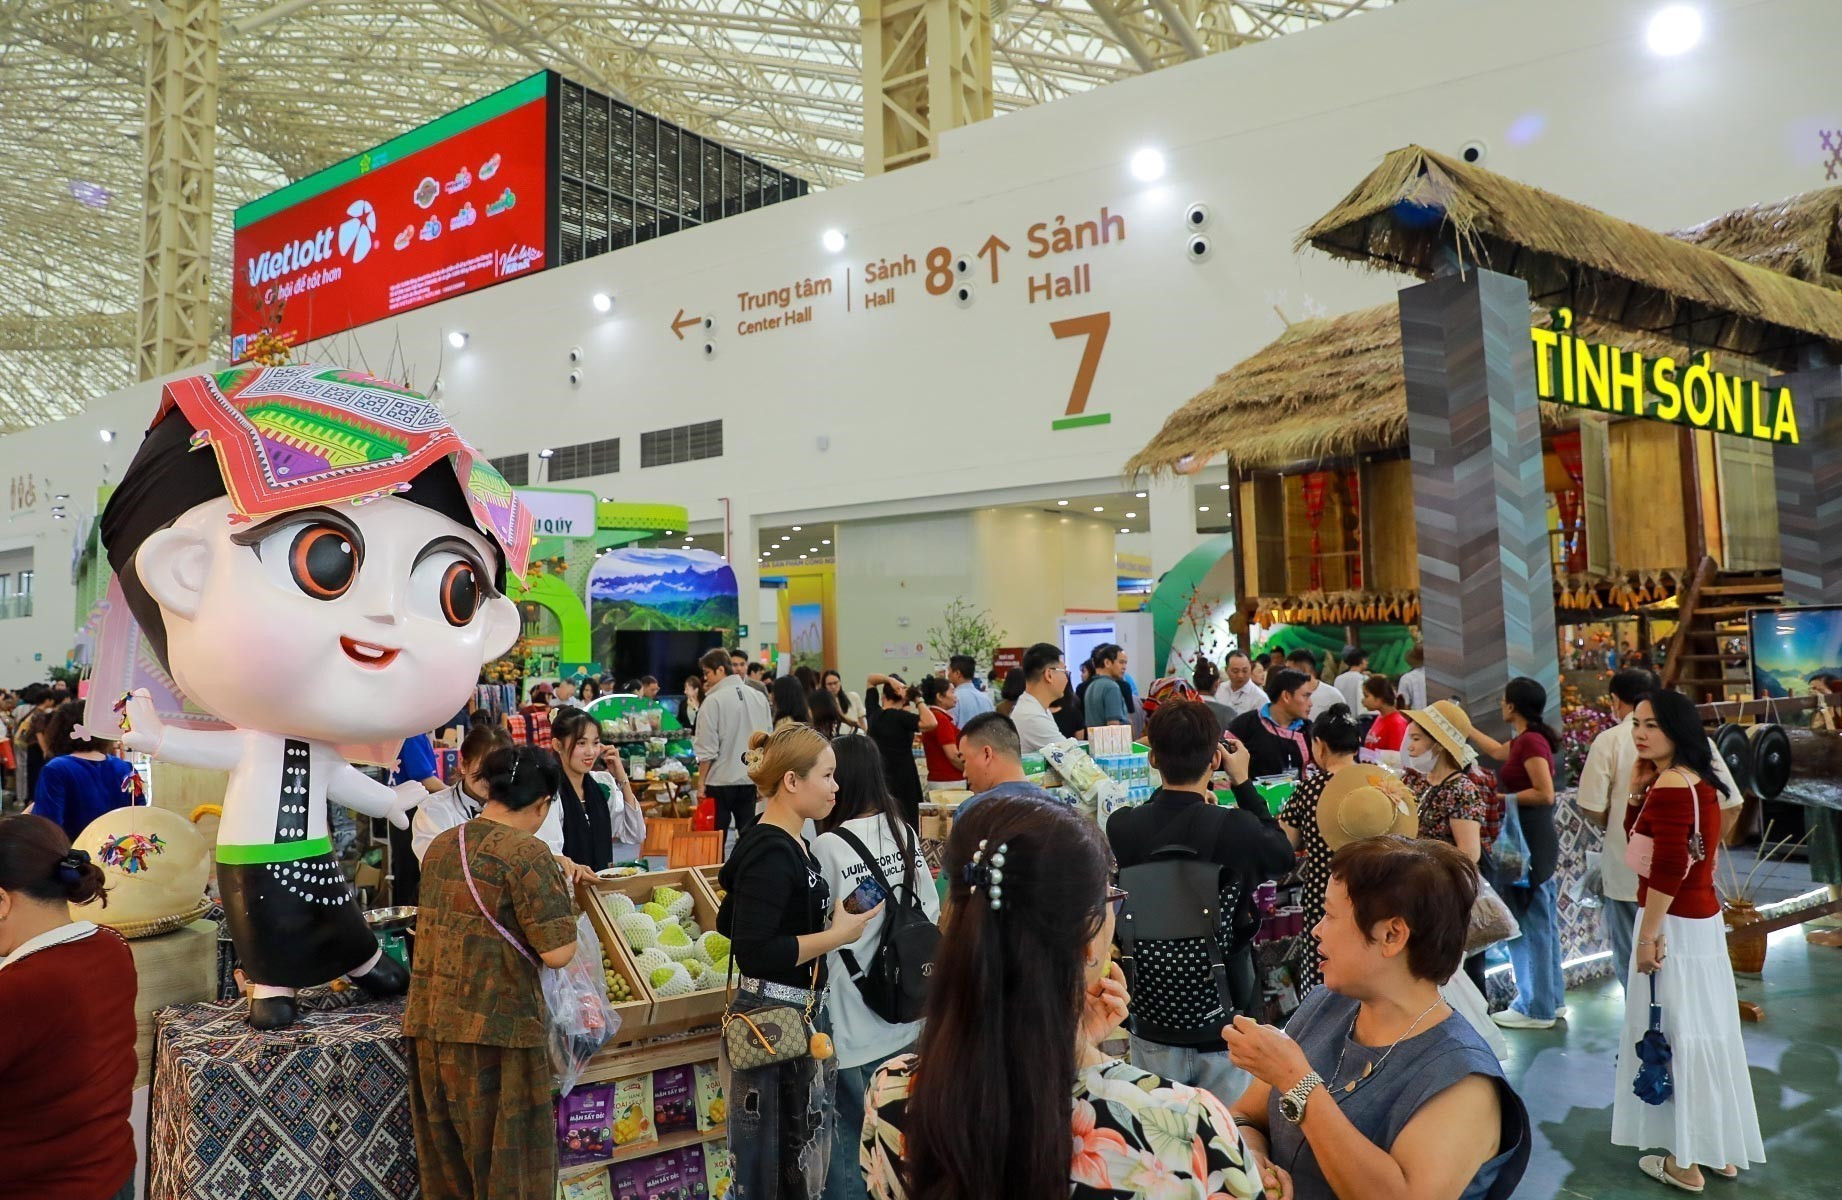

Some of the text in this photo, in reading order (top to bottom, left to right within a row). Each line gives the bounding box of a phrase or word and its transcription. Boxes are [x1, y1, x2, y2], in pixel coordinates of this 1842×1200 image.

[1026, 206, 1126, 260] Sảnh
[248, 226, 335, 287] Vietlott
[864, 246, 954, 296] Sảnh 8
[737, 278, 833, 312] Trung tâm
[864, 288, 895, 309] Hall
[1027, 263, 1091, 304] Hall
[737, 305, 812, 336] Center Hall
[1049, 311, 1111, 416] 7
[1530, 306, 1800, 444] TỈNH SƠN LA
[584, 1112, 596, 1121] SẤY
